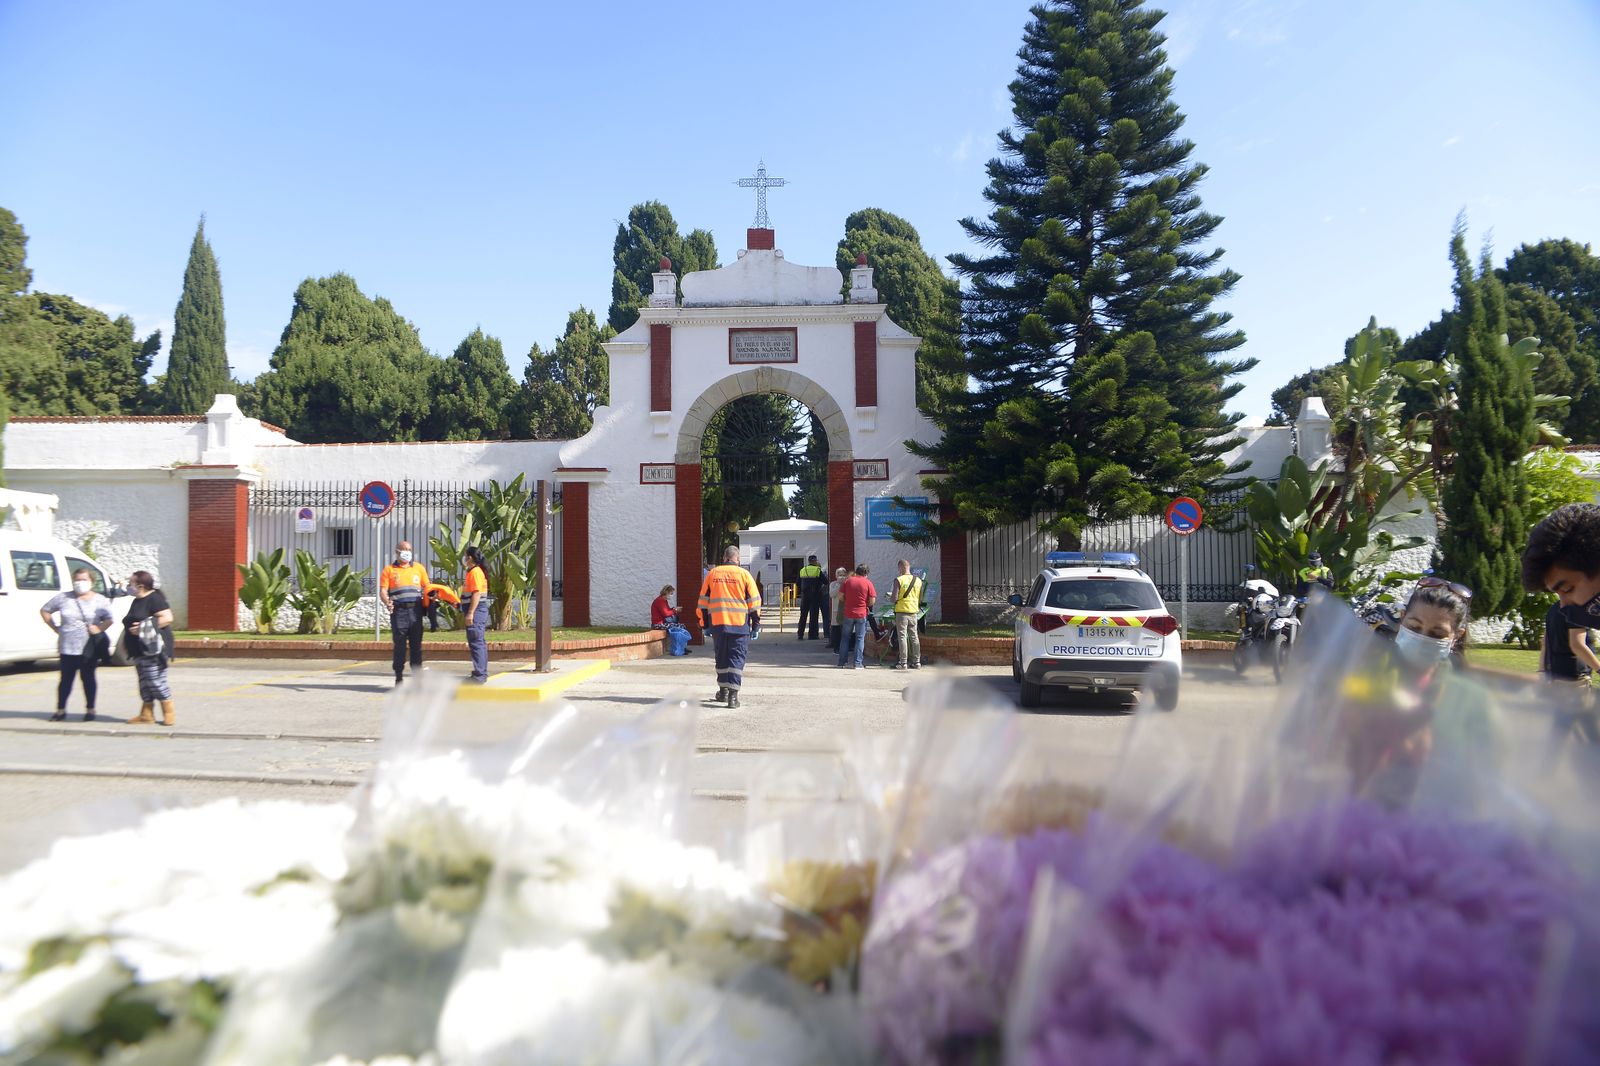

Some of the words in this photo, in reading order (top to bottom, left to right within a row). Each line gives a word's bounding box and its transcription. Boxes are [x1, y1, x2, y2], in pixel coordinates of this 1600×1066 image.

[1085, 628, 1106, 637] 1315
[1109, 628, 1125, 637] KYK
[1053, 645, 1123, 656] PROTECCION
[1127, 647, 1153, 656] CIVIL
